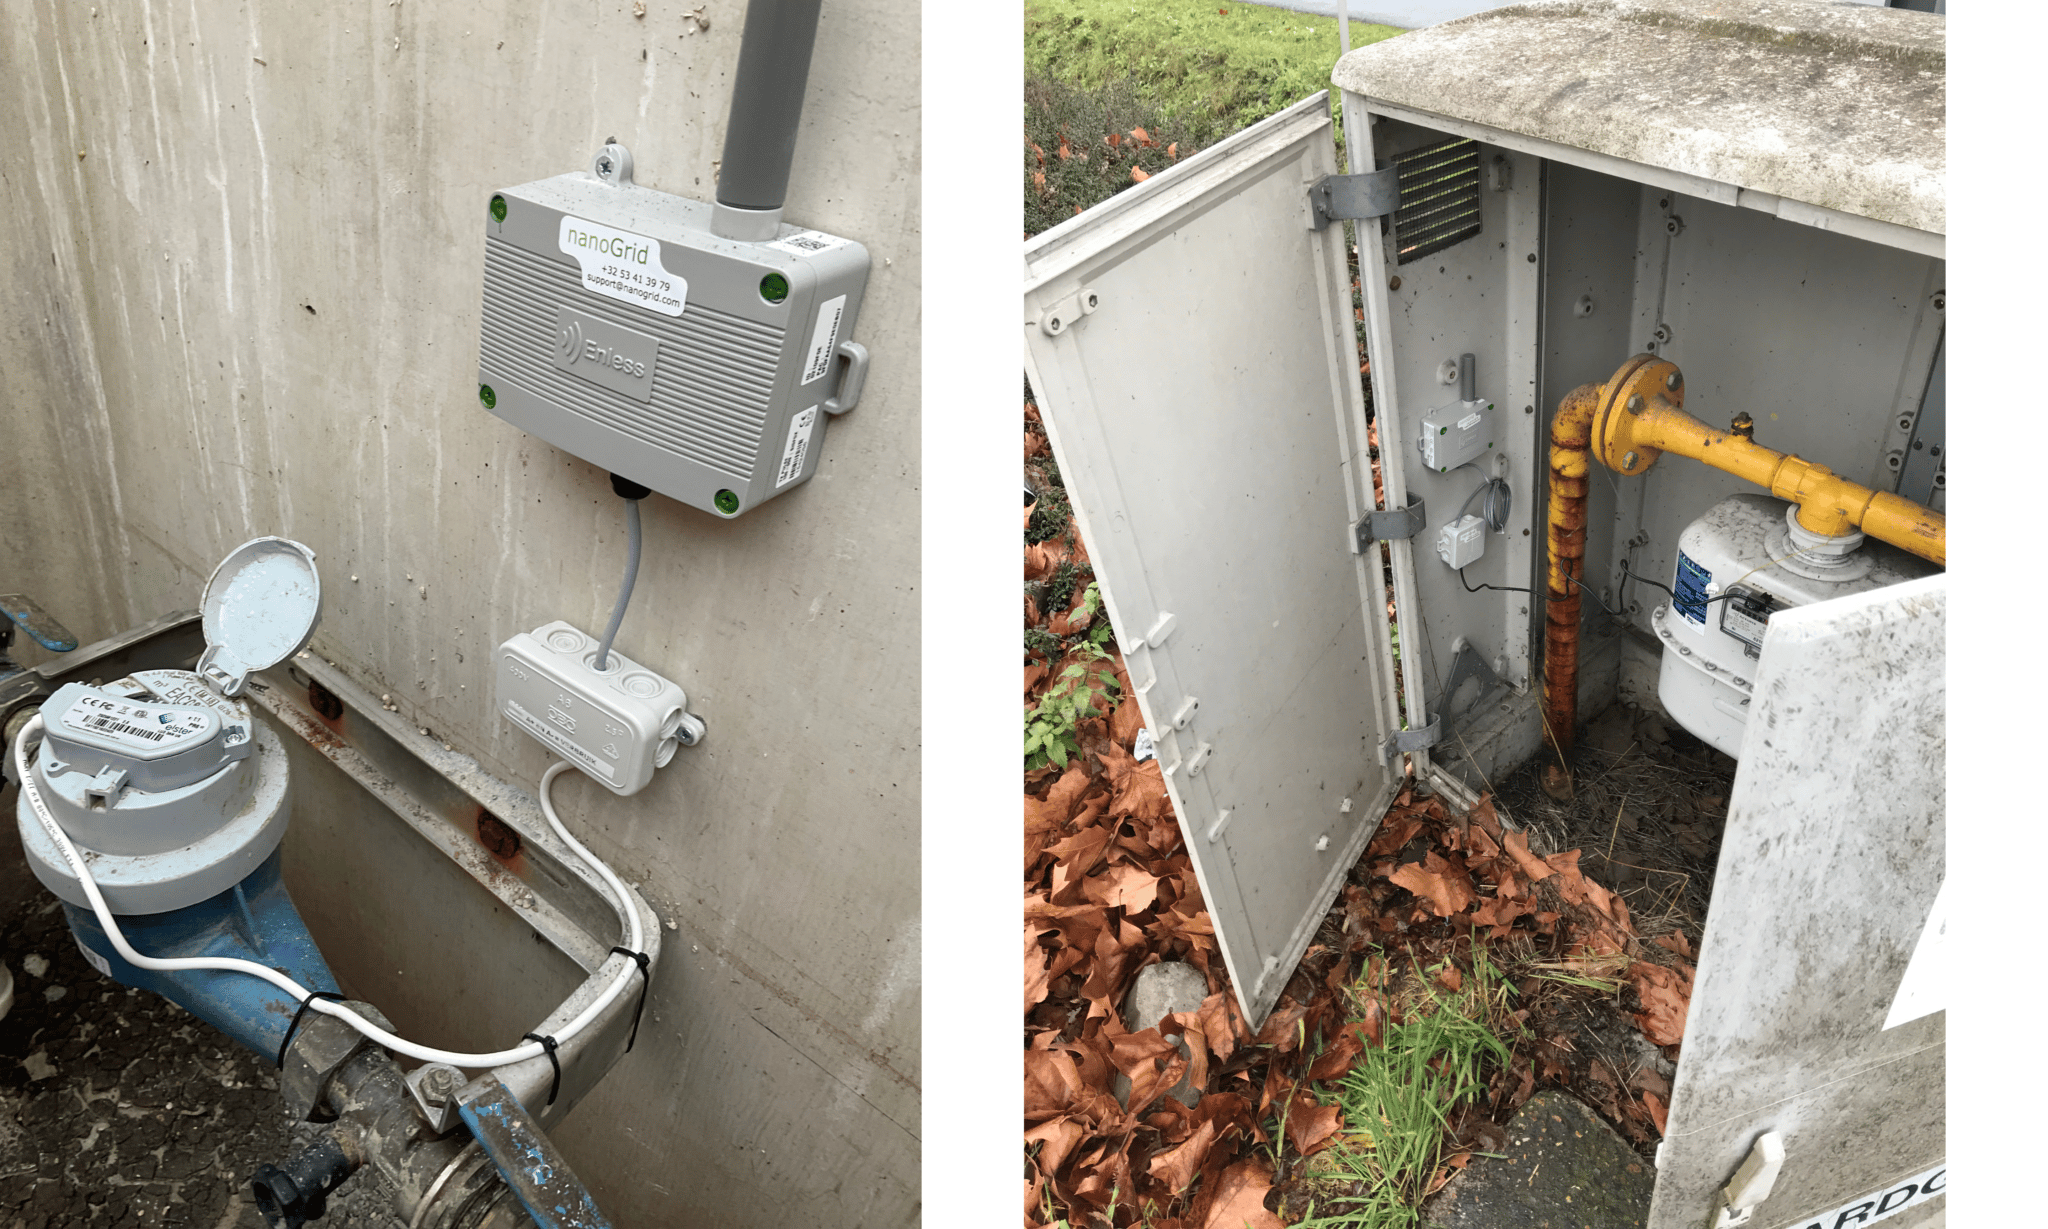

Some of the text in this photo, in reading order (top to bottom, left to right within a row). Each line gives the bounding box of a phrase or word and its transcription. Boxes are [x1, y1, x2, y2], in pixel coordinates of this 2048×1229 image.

[568, 229, 649, 265] nanoGrid
[587, 273, 681, 308] support@nanogrid.com
[602, 265, 671, 291] +32 53 41 39 79
[584, 339, 645, 378] Enless
[165, 724, 194, 735] elster
[1805, 1168, 1946, 1229] RDG
